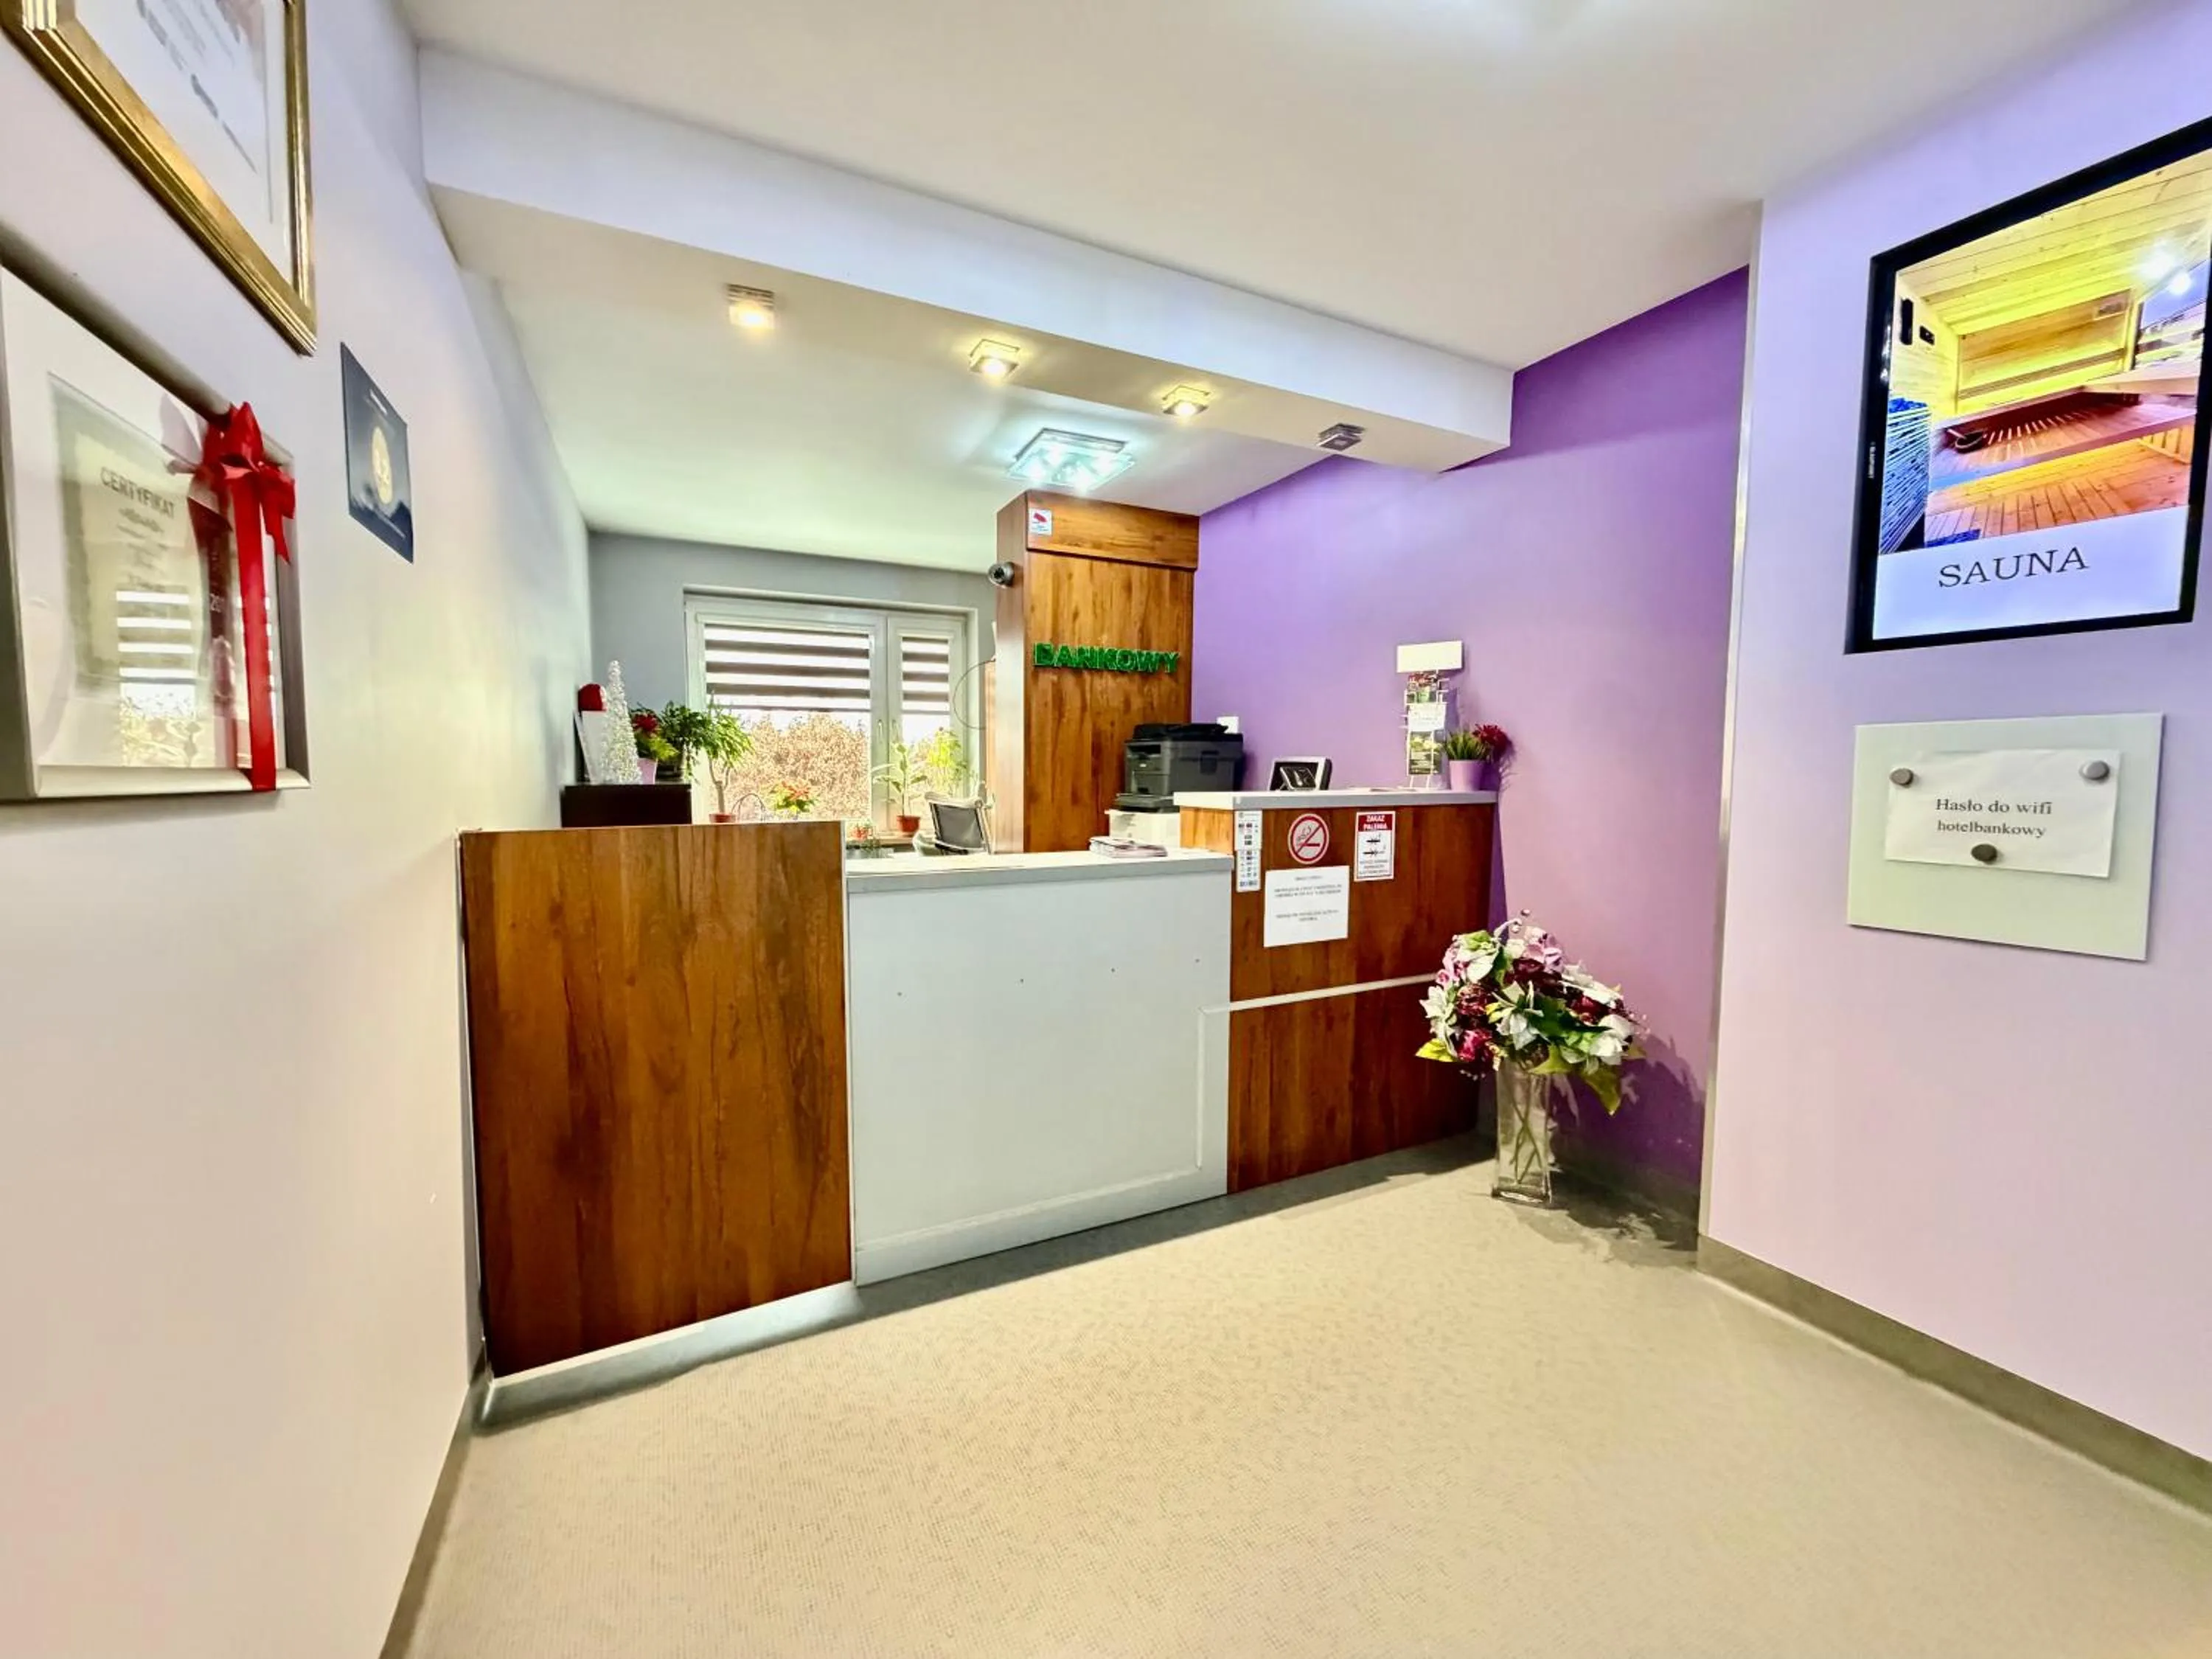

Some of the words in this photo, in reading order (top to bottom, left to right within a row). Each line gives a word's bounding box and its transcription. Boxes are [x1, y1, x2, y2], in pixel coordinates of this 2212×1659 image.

[100, 467, 175, 518] CERTYFIKAT
[1938, 547, 2089, 588] SAUNA
[1033, 642, 1180, 672] BANKOWY
[1935, 799, 1983, 813] Hasło
[1988, 799, 2010, 813] do
[2017, 801, 2053, 815] wifi
[1938, 821, 2046, 838] hotelbankowy
